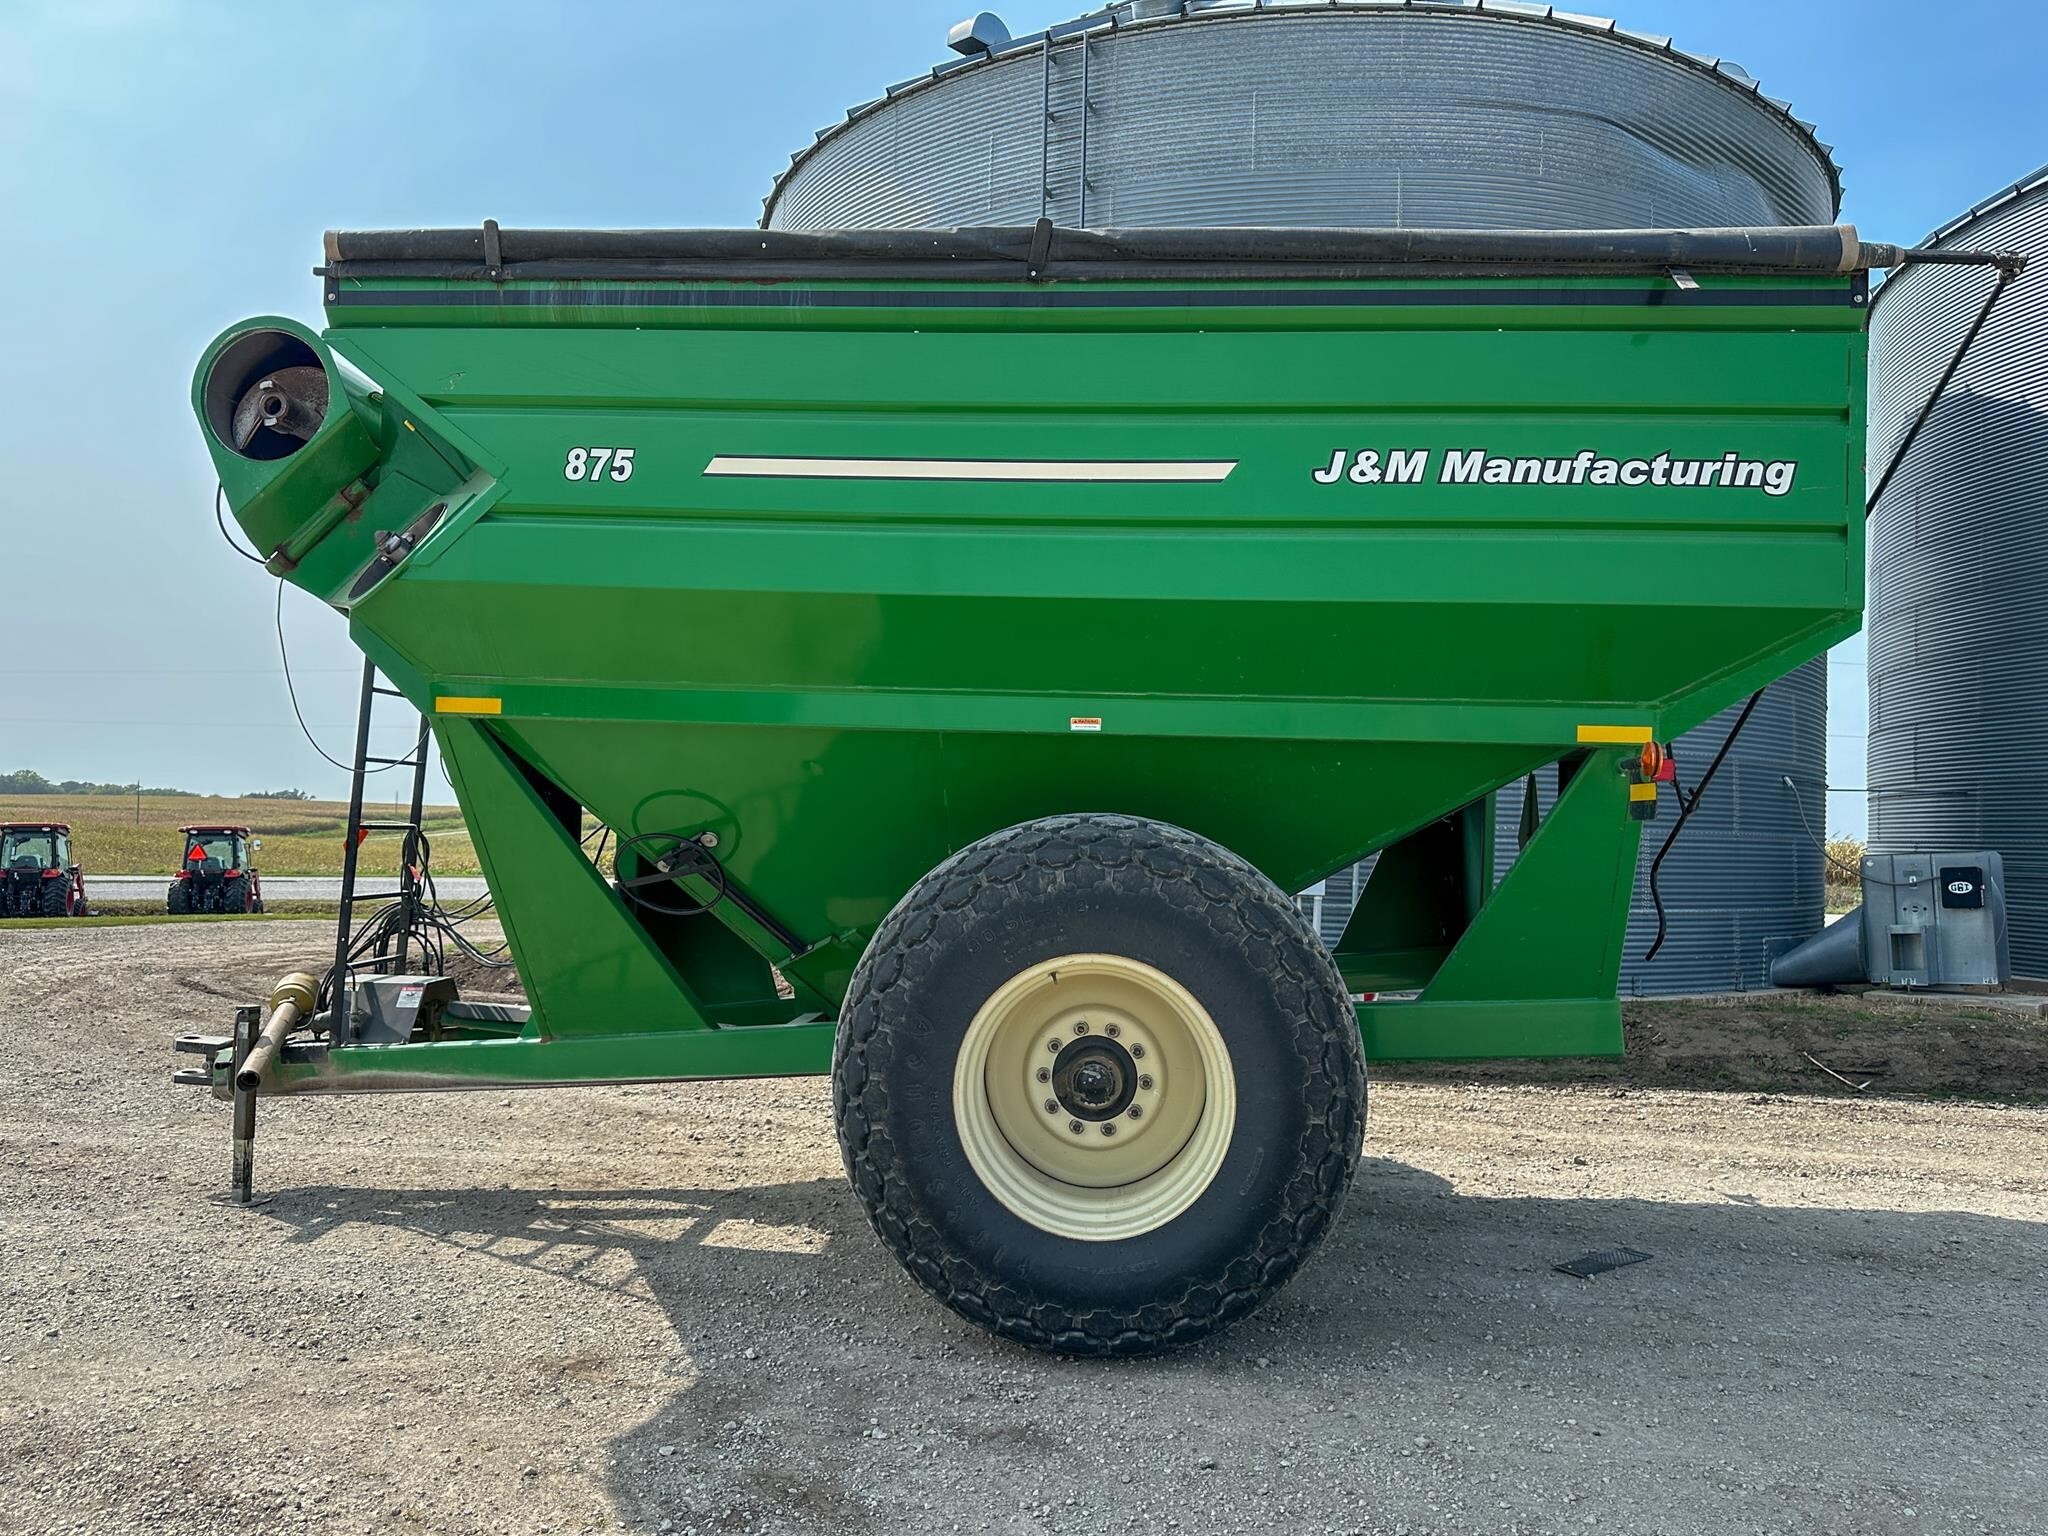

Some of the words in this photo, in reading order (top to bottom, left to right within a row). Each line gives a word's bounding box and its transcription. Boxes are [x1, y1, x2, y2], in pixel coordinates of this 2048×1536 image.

[564, 447, 635, 482] 875
[1312, 449, 1431, 485] J&M
[1437, 449, 1799, 497] Manufacturing
